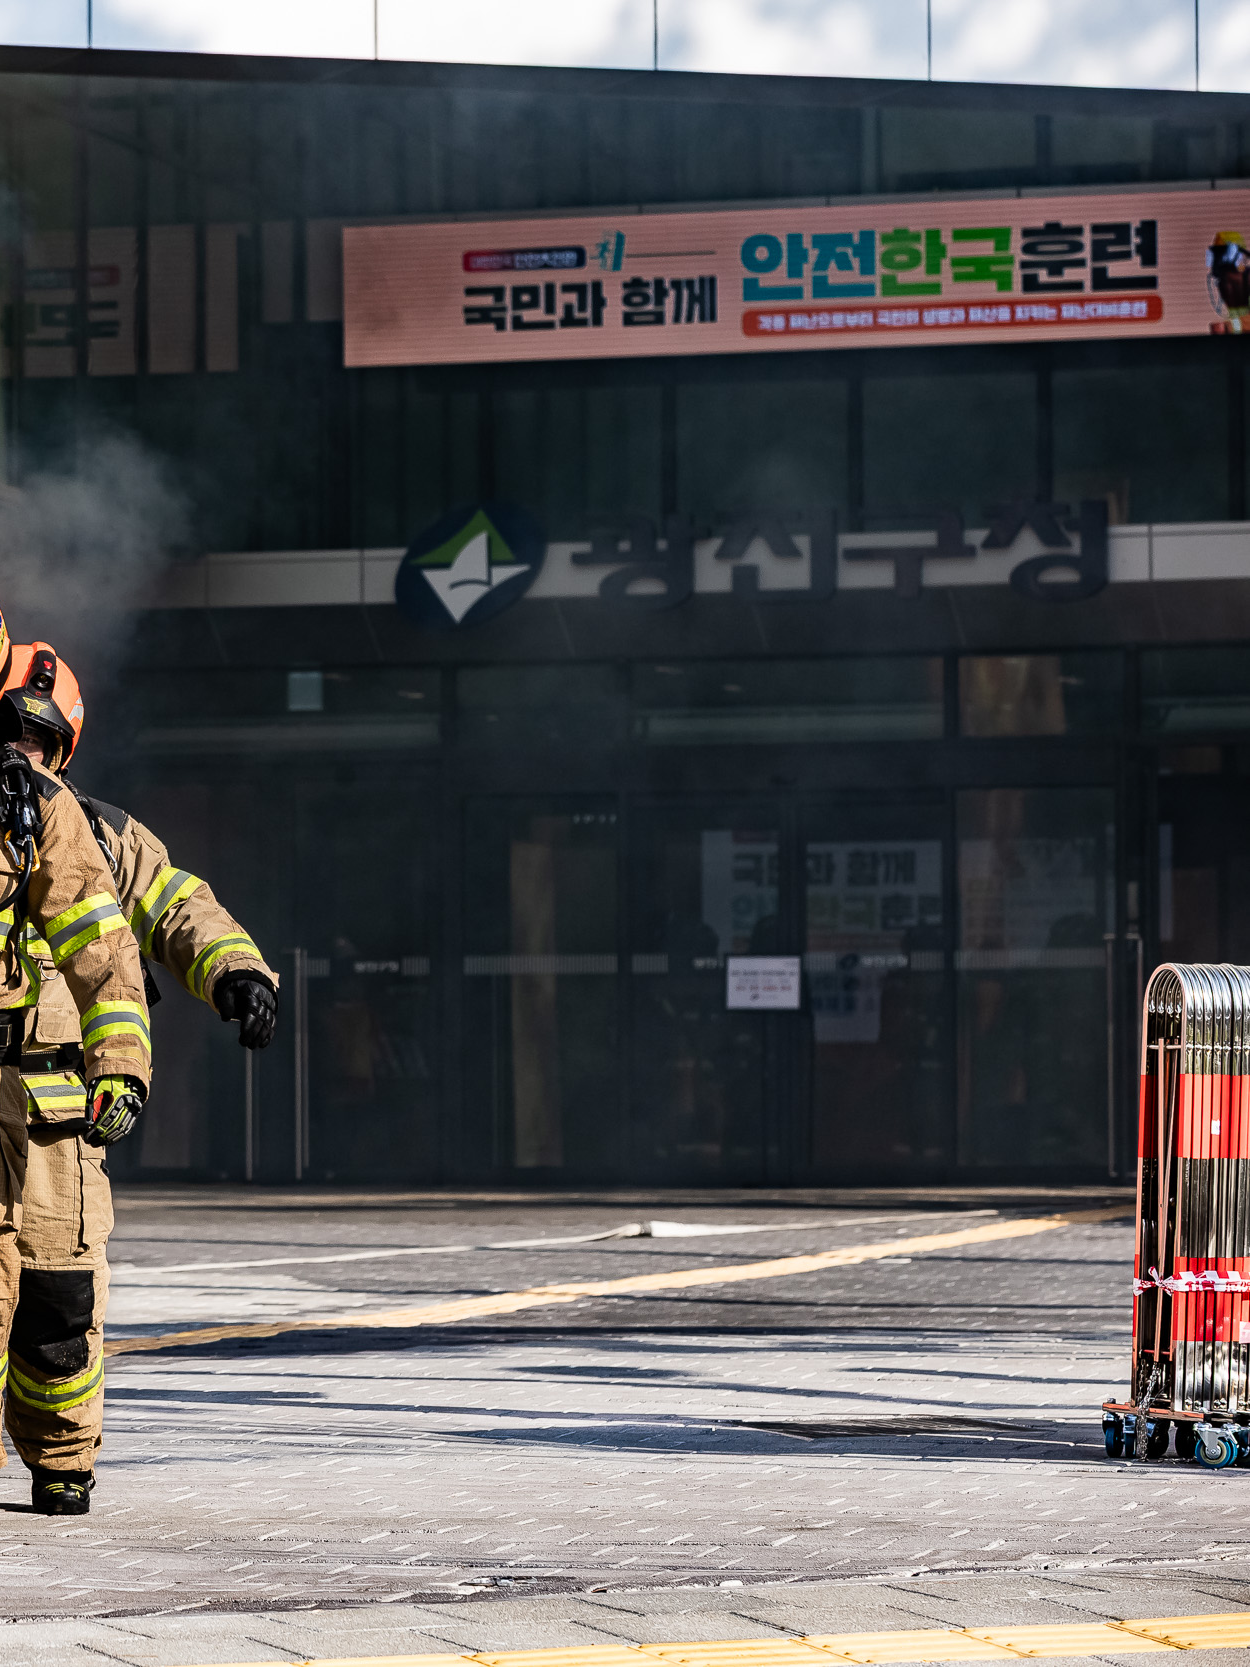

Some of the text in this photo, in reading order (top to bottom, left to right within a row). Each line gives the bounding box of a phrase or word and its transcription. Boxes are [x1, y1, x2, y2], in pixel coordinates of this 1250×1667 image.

[740, 220, 1158, 301] 안전한국훈련
[463, 275, 717, 331] 국민과 함께
[571, 498, 1108, 612] 광진구청
